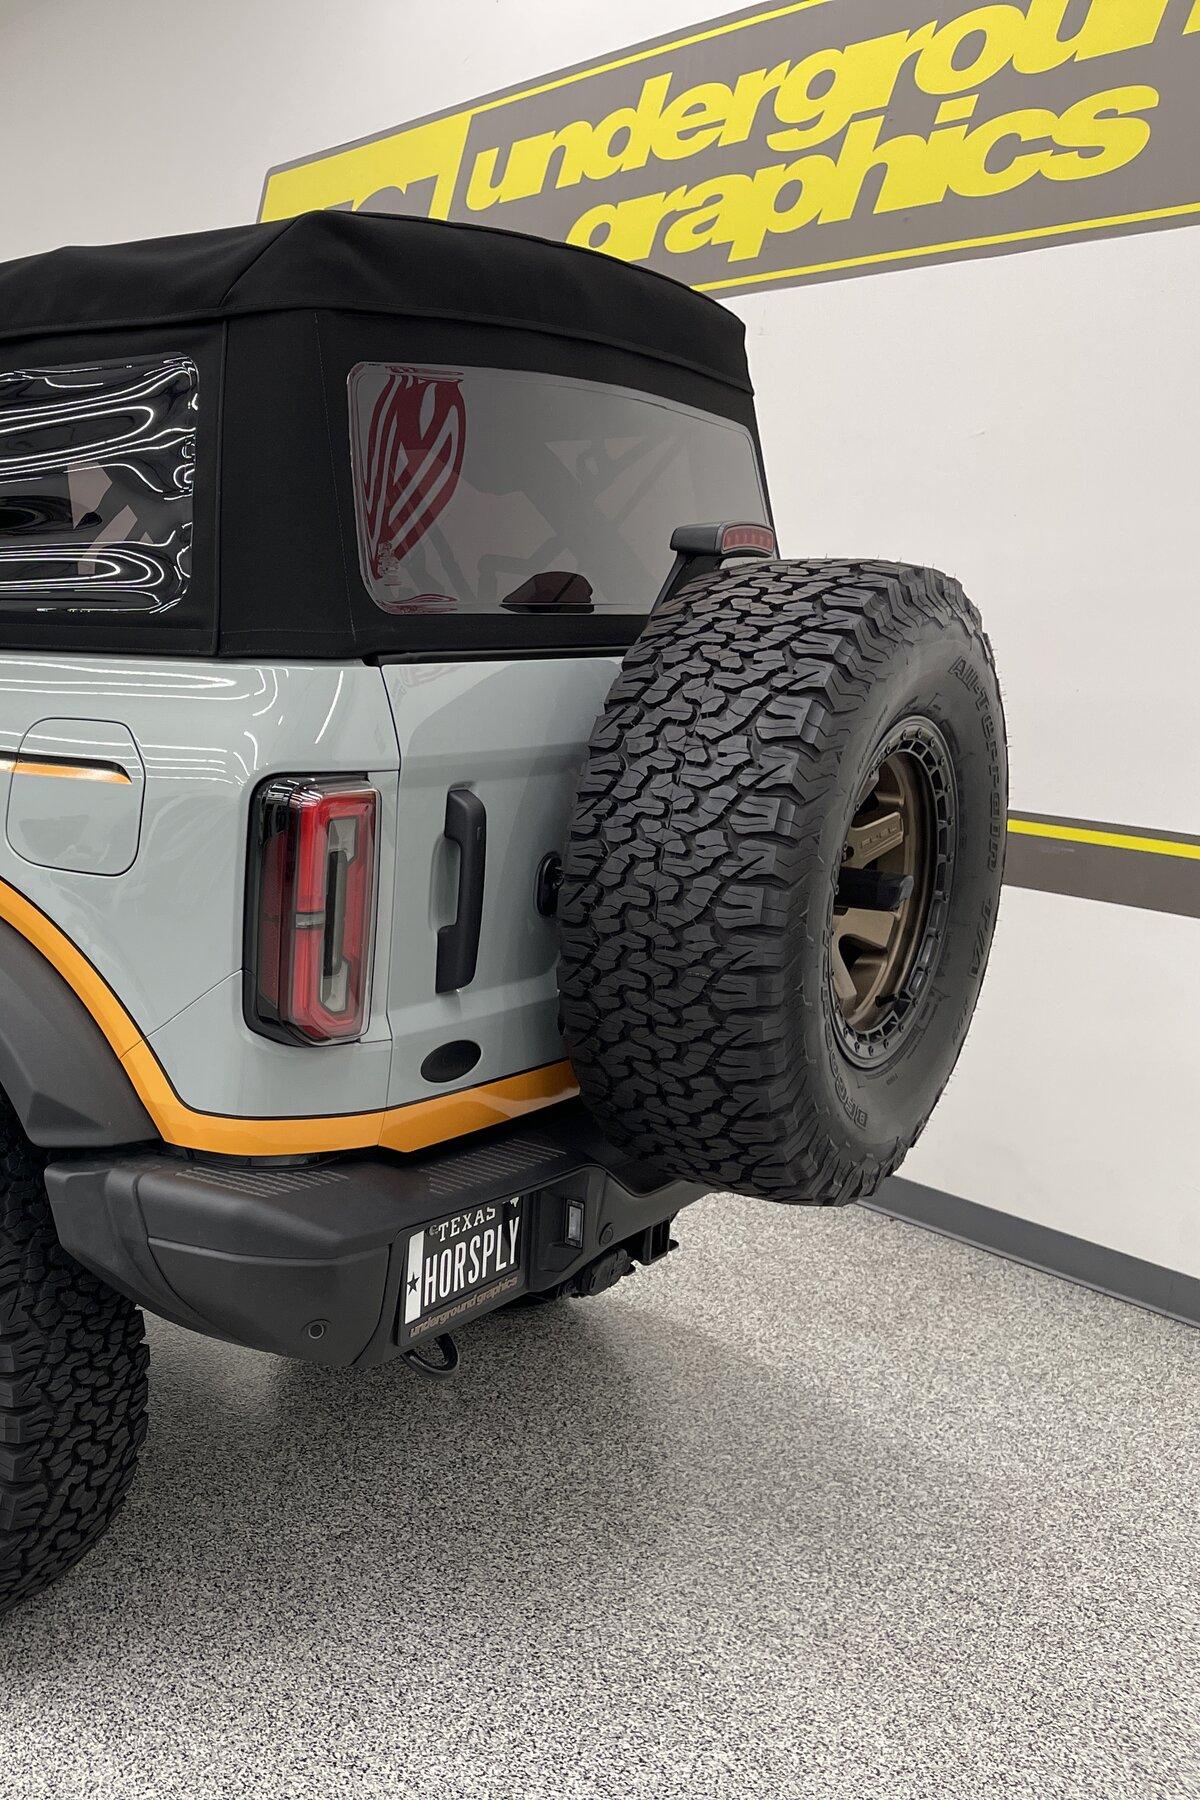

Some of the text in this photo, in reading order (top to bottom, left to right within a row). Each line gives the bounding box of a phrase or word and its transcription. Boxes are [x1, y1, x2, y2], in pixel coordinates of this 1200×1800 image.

[465, 0, 1200, 211] undergrou
[565, 84, 1159, 263] graphics
[423, 1216, 520, 1307] HORSPLY
[437, 1206, 496, 1242] TEXAS
[408, 1275, 519, 1338] underground graphics
